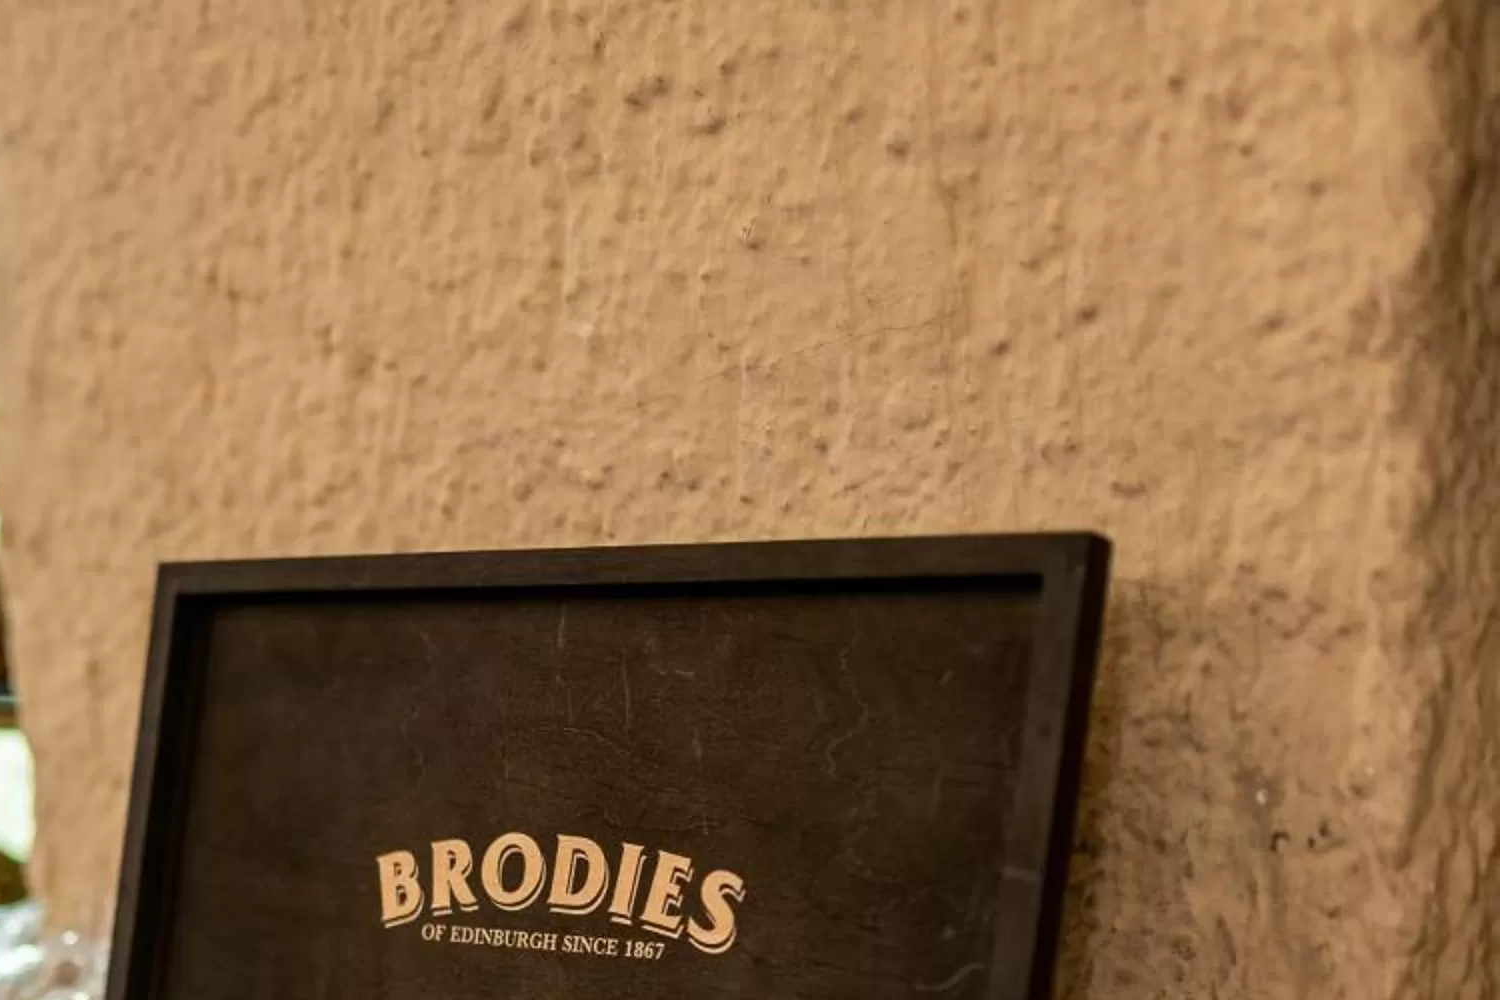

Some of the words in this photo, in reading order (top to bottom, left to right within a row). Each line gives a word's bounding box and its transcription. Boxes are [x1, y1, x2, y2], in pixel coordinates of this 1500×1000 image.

[376, 832, 746, 954] BRODIES
[421, 923, 447, 942] OF
[450, 925, 558, 951] EDINBURGH
[562, 933, 619, 956] SINCE
[625, 940, 665, 960] 1867
